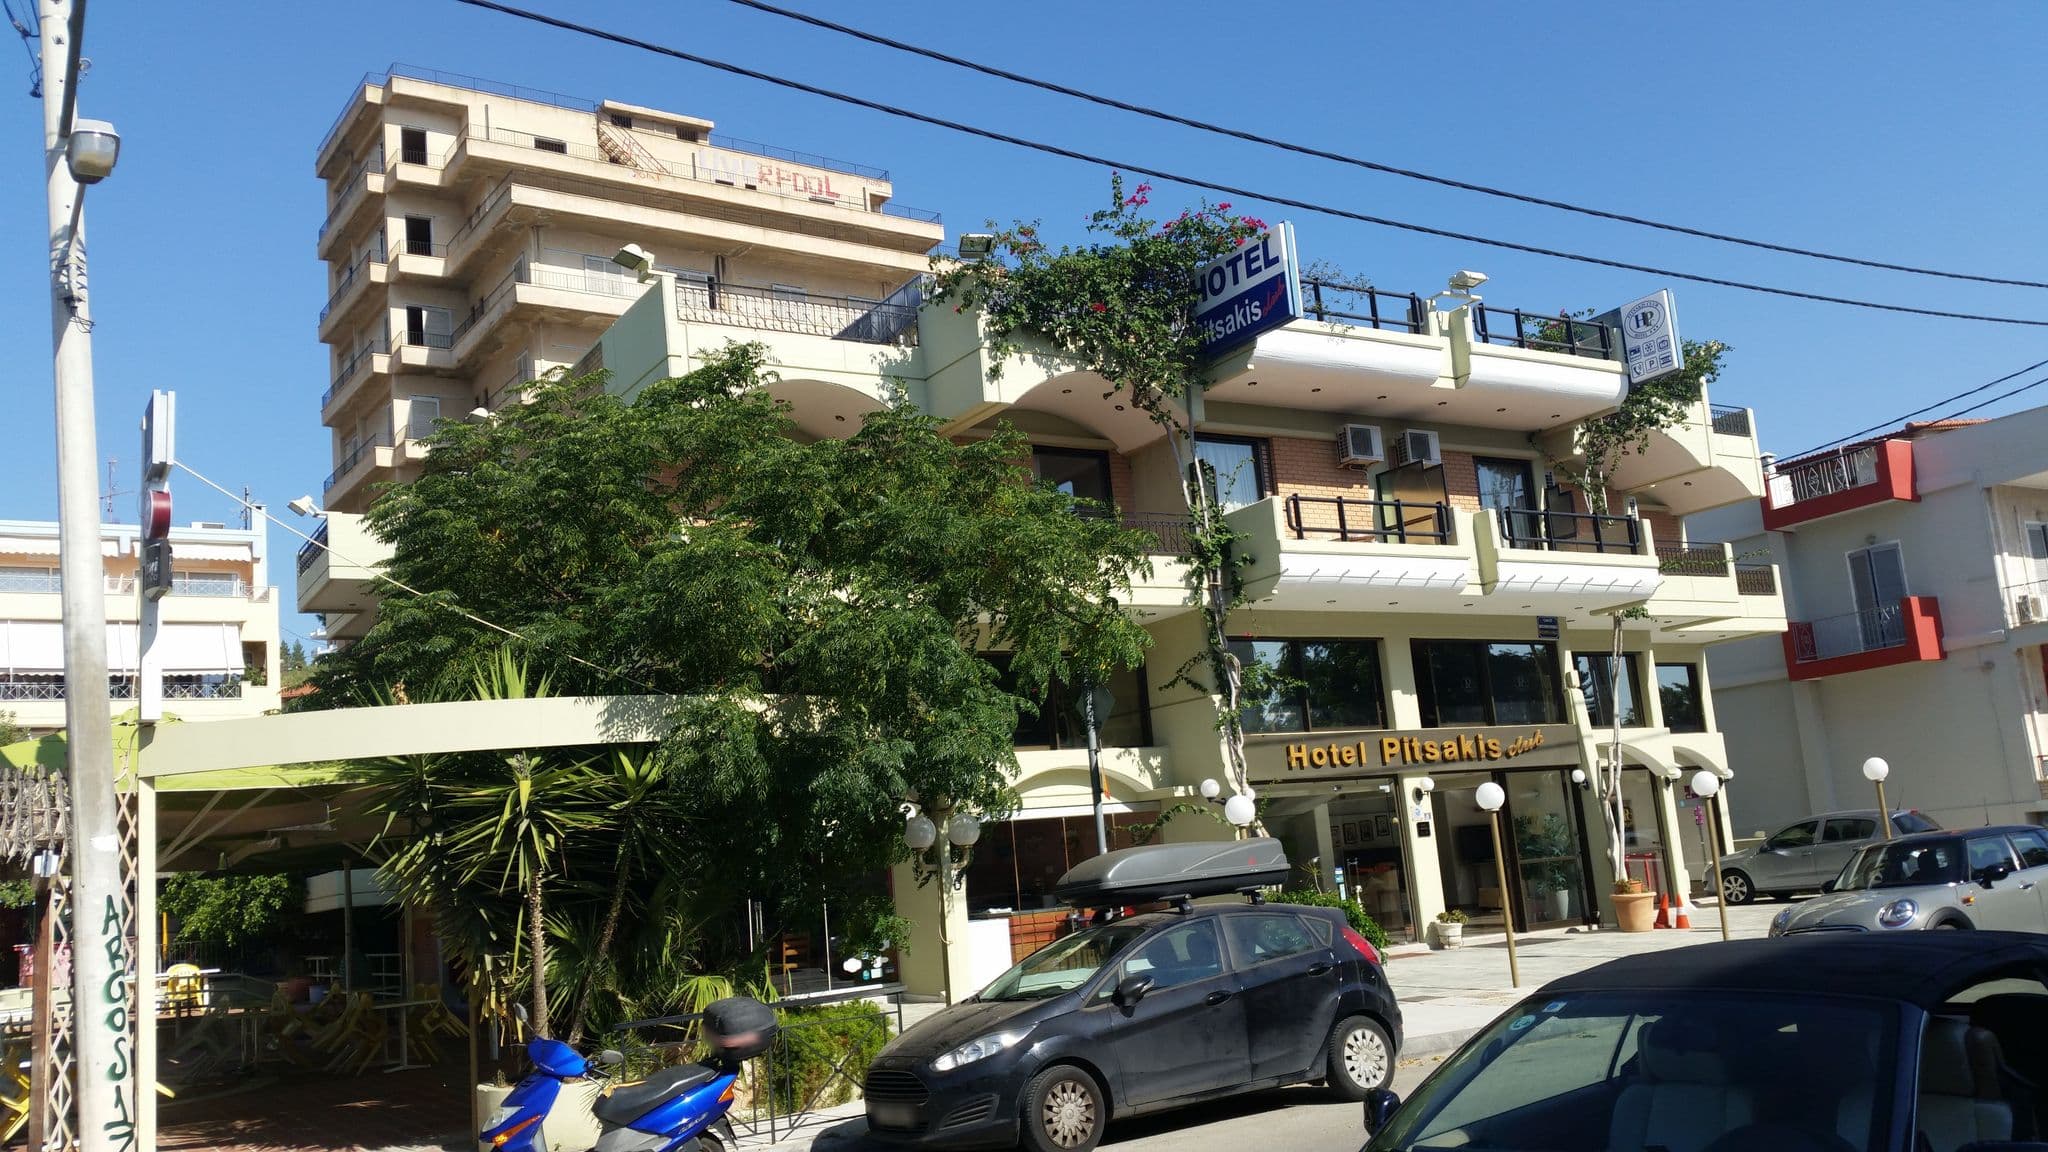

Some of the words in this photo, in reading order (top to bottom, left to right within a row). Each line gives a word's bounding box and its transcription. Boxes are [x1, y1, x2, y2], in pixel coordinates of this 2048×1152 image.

[1195, 298, 1262, 345] itsakis
[1287, 741, 1367, 771] Hotel
[1380, 733, 1502, 766] Pitsakis
[1505, 729, 1545, 760] club
